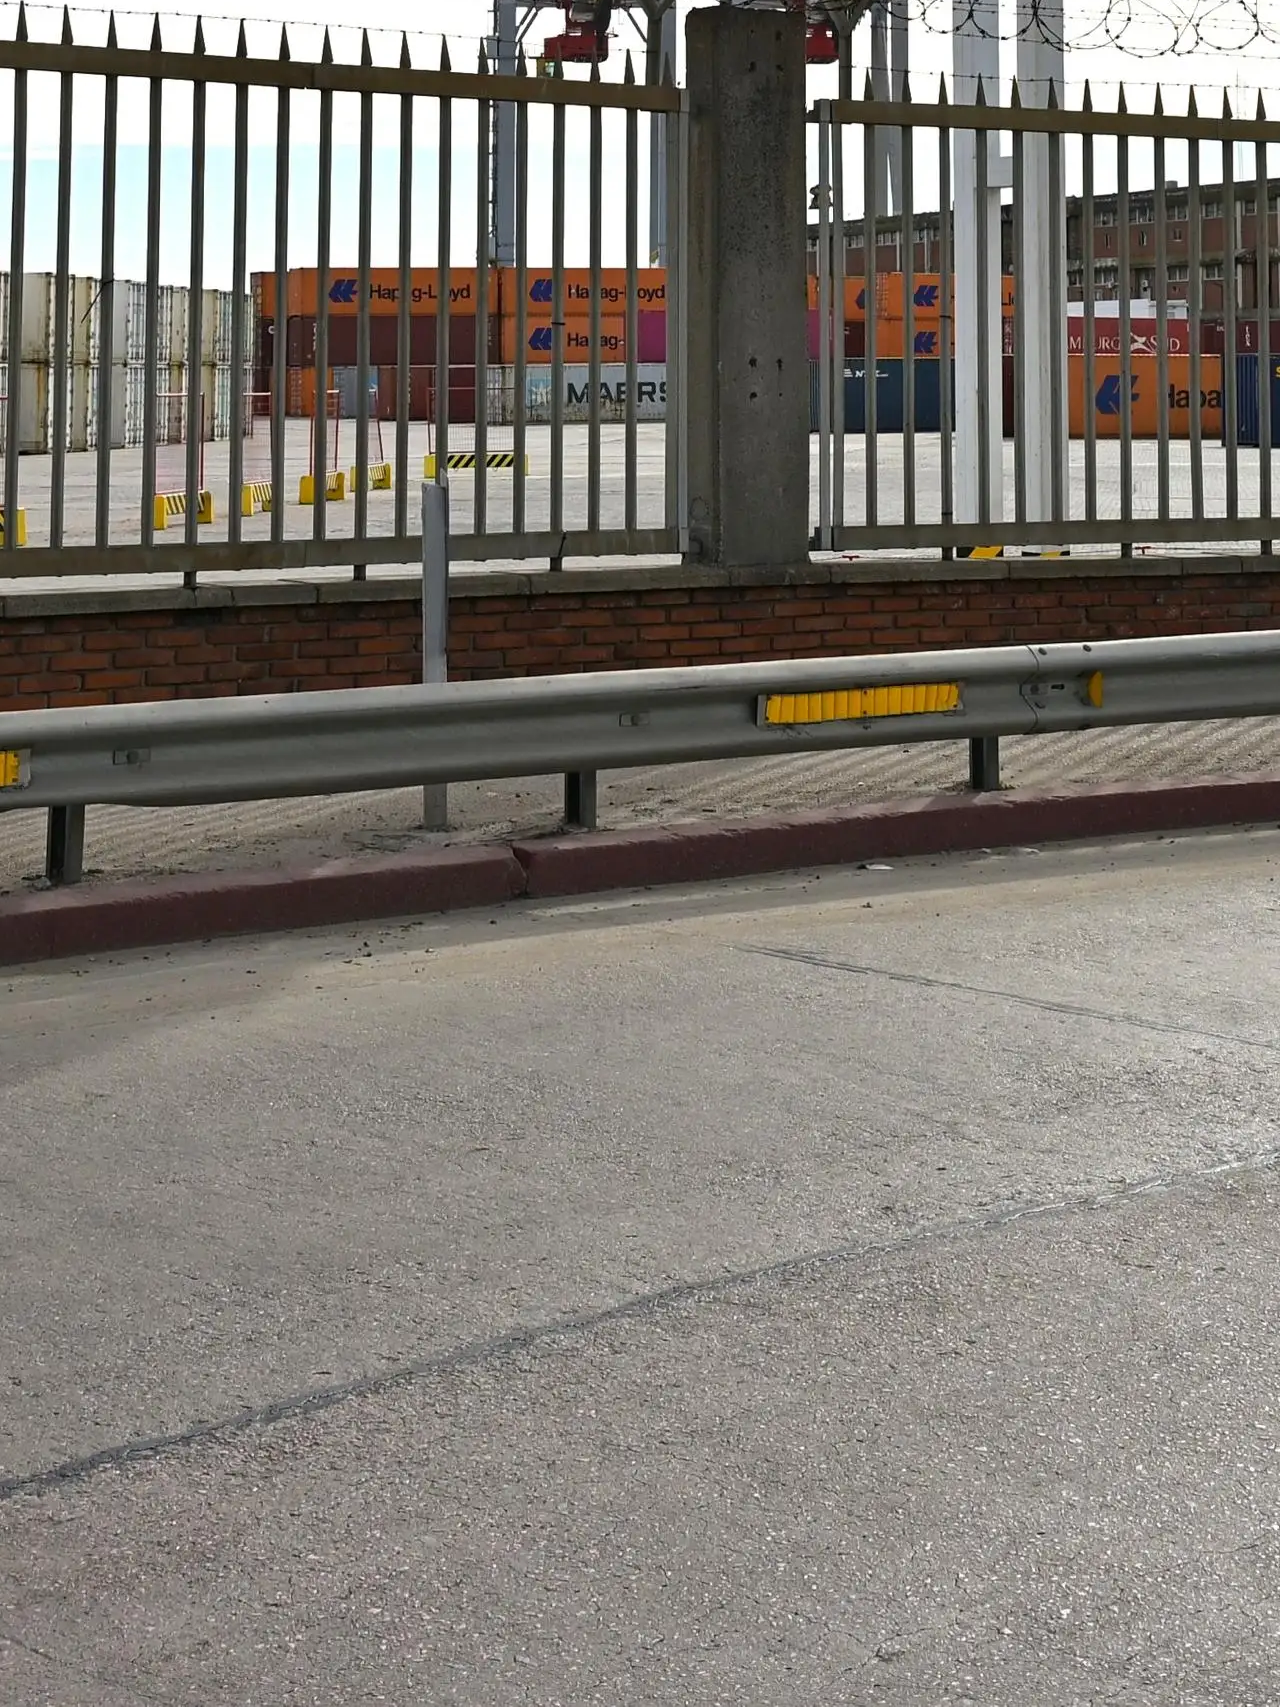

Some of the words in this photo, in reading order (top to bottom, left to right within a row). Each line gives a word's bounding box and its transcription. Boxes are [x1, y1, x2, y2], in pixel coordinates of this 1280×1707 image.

[368, 283, 471, 302] Hapg-Lyd
[567, 283, 666, 302] Haag-oyd
[567, 332, 625, 350] Haag-
[1150, 335, 1180, 351] SD
